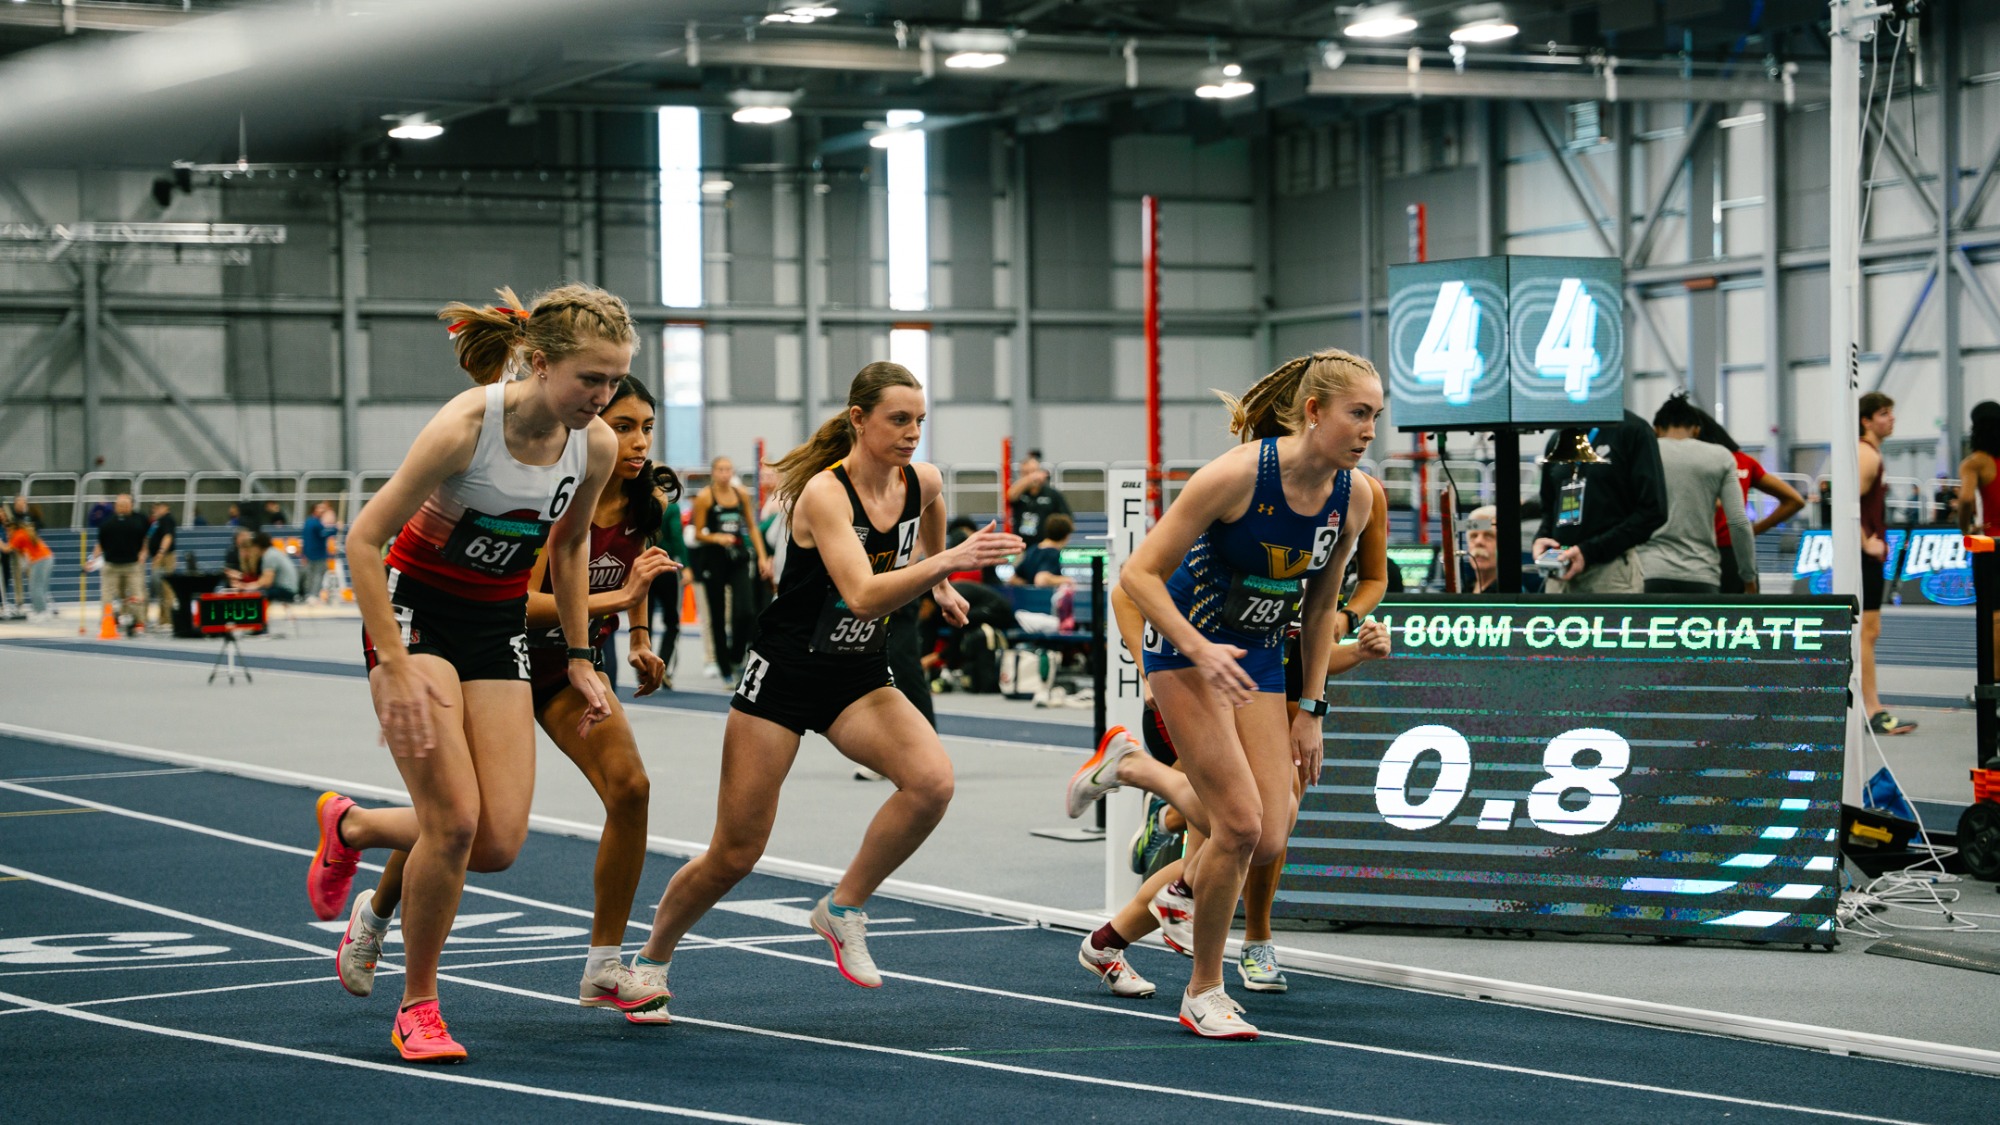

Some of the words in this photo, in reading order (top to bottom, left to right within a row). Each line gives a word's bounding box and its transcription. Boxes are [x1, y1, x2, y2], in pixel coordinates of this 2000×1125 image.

[1413, 281, 1482, 403] 4
[1535, 278, 1600, 402] 4
[549, 476, 576, 519] 6
[1121, 481, 1141, 489] GILL
[465, 536, 522, 567] 631
[900, 522, 915, 560] 4
[1313, 529, 1336, 567] 3
[1906, 533, 1968, 575] LEVEL
[1240, 597, 1284, 624] 793
[830, 617, 878, 643] 595
[1403, 615, 1512, 648] 800M
[1523, 616, 1824, 651] COLLEGIATE
[744, 658, 763, 698] 4
[1374, 724, 1631, 837] 0.8
